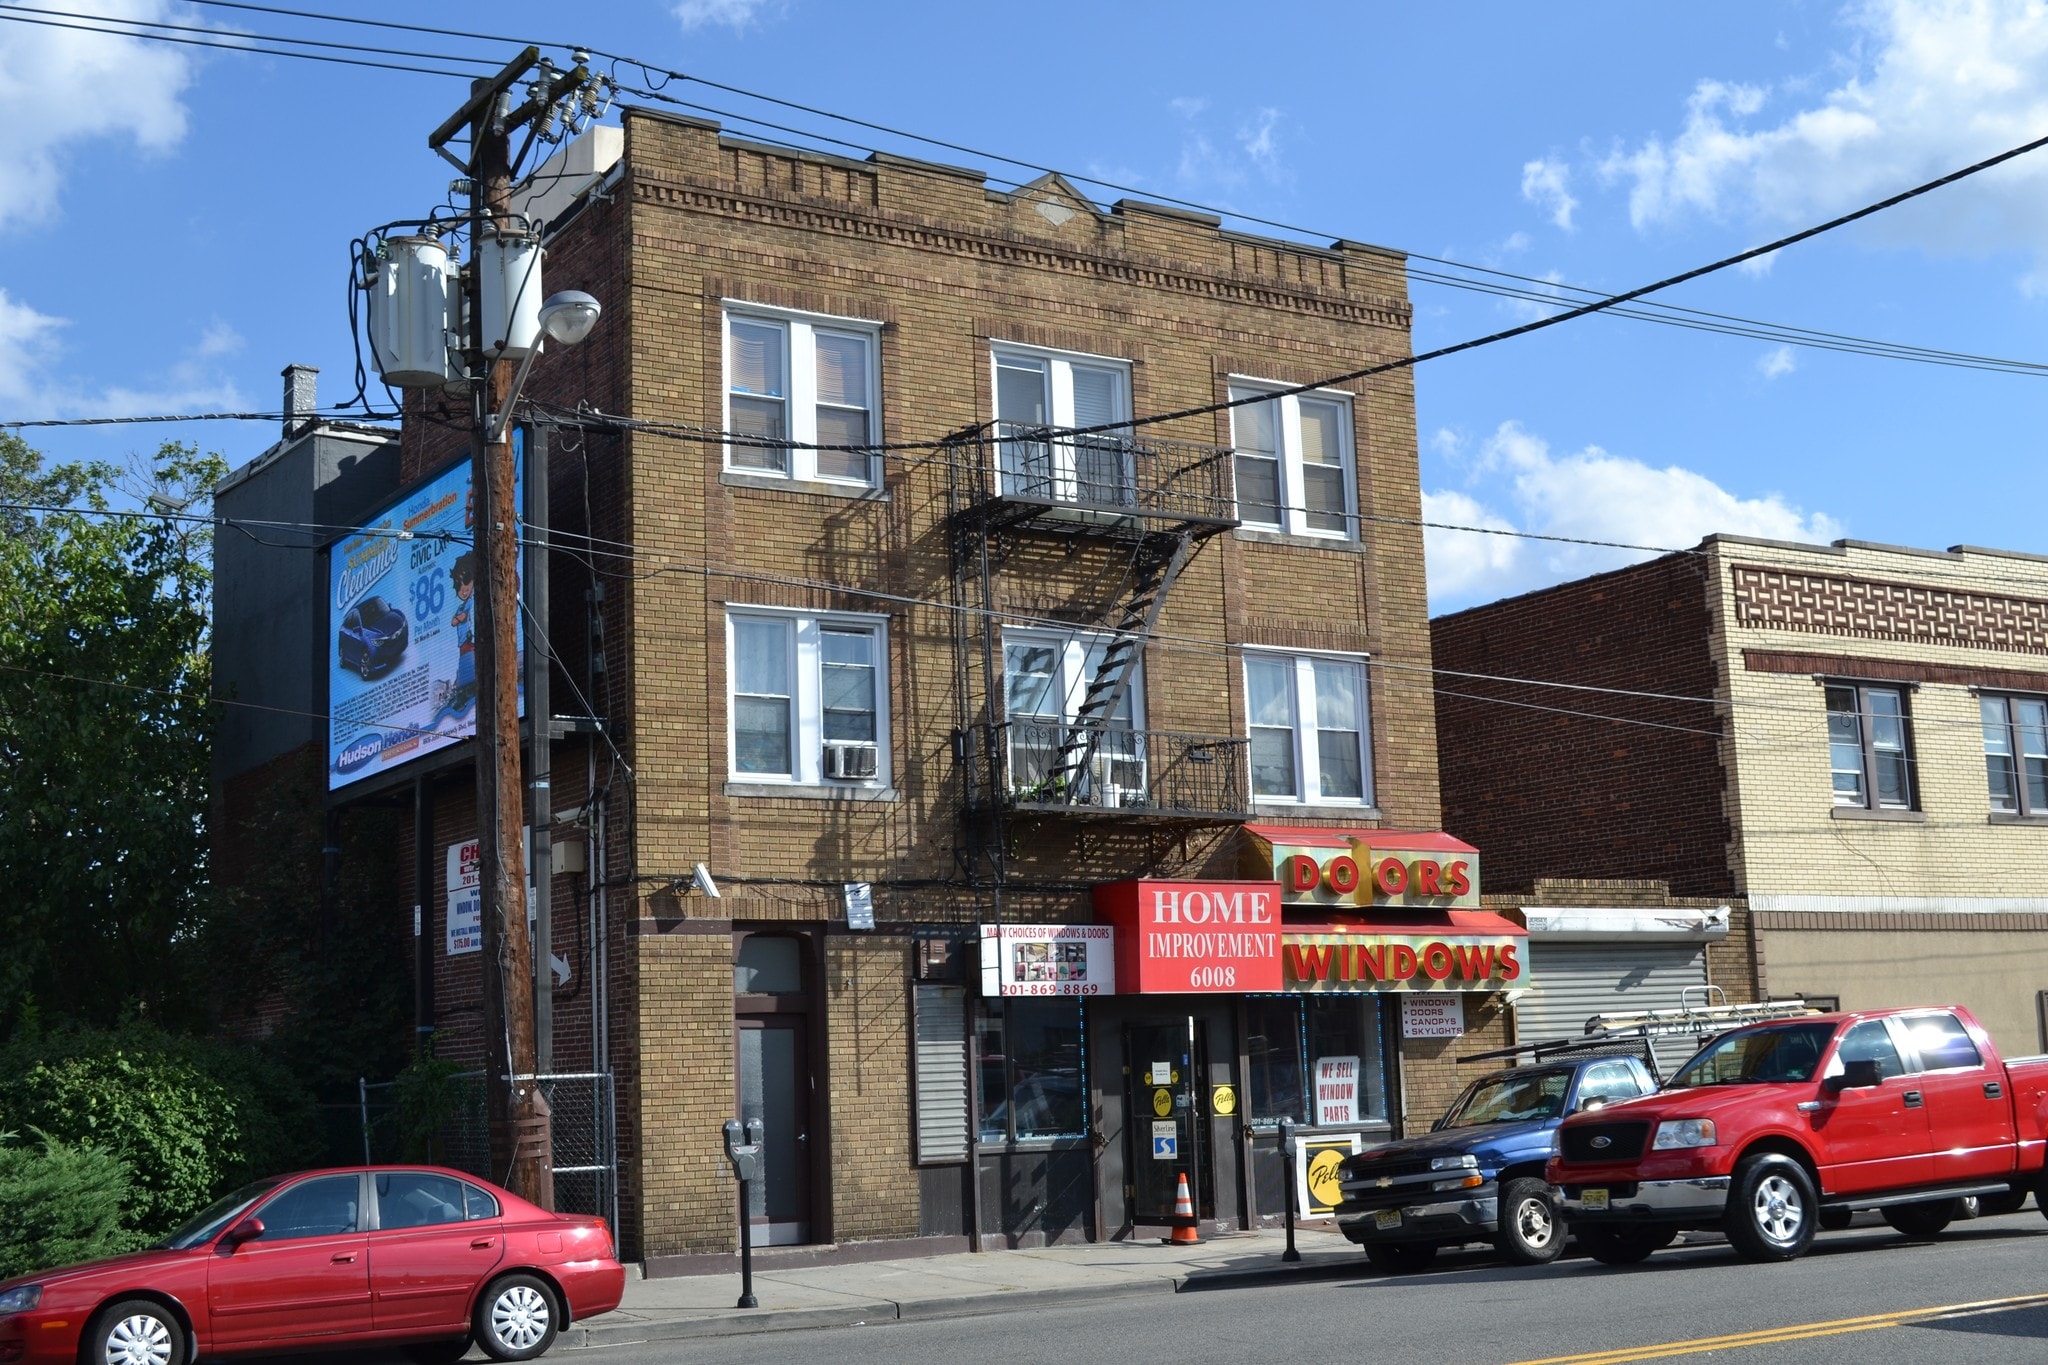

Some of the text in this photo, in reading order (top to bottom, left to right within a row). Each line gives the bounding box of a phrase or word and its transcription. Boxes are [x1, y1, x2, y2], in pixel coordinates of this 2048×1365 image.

[403, 492, 458, 531] Summerbration
[408, 497, 431, 517] Honda
[410, 544, 432, 570] CIVIC
[336, 539, 399, 611] Clearance
[339, 739, 382, 768] Hudson
[1289, 854, 1471, 897] DOORS
[1152, 890, 1272, 925] HOME
[986, 927, 1110, 939] MANY CHOICES OF WINDOWS & DOORS
[1148, 932, 1276, 959] IMPROVEMENT
[1287, 941, 1521, 982] WINDOWS
[1190, 966, 1236, 988] 6008
[1001, 983, 1098, 995] 201-869-8869
[1410, 999, 1456, 1007] WINDOWS
[1410, 1008, 1444, 1016] DOORS
[1411, 1018, 1457, 1026] CANOPYS
[1411, 1027, 1463, 1036] SKYLIGHTS
[1321, 1062, 1353, 1079] WE SELL
[1319, 1083, 1354, 1101] WINDOW
[1251, 1117, 1282, 1126] 201-869-8
[1323, 1105, 1350, 1123] PARTS
[1311, 1161, 1340, 1191] Pell
